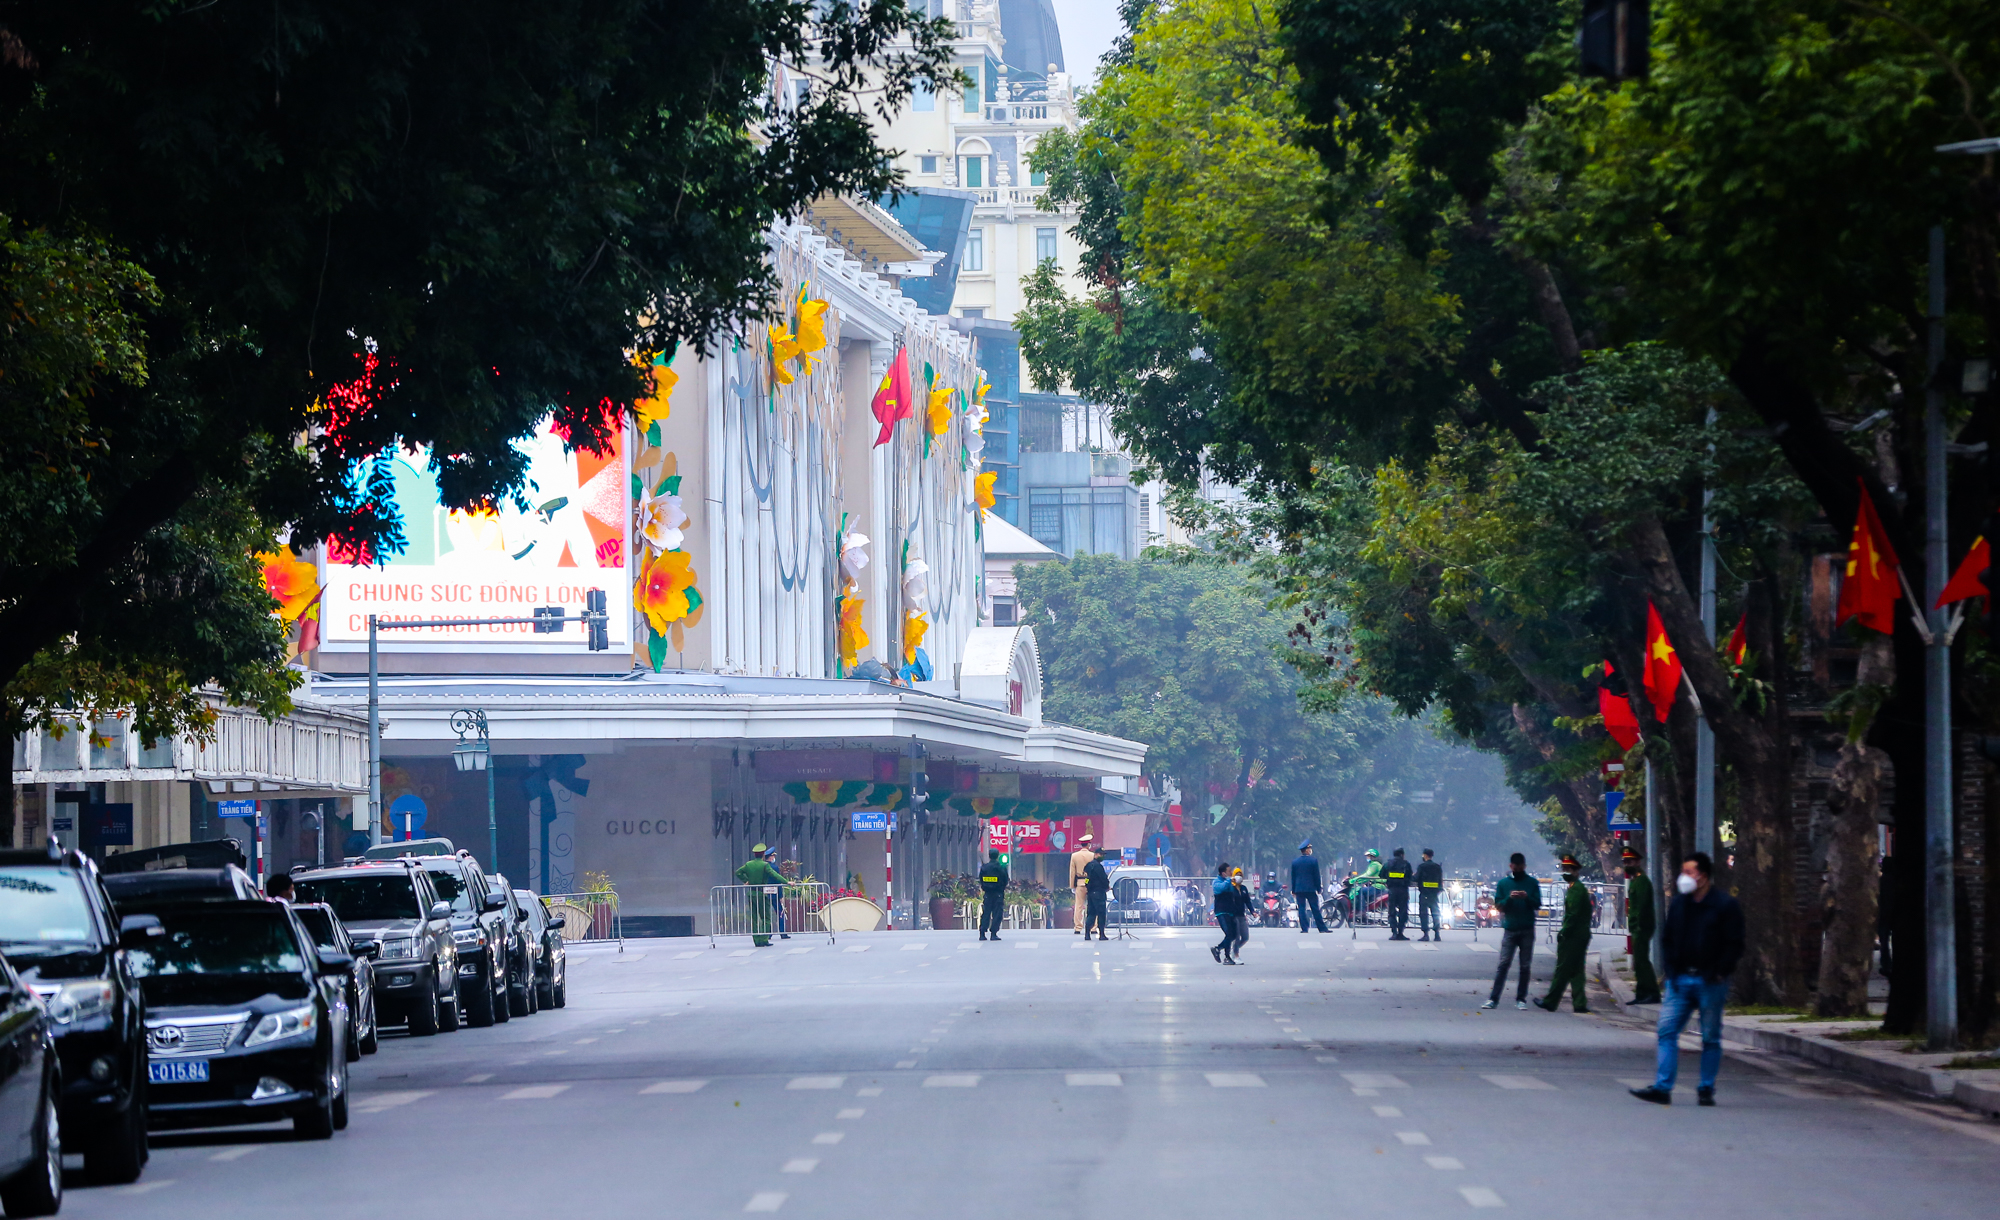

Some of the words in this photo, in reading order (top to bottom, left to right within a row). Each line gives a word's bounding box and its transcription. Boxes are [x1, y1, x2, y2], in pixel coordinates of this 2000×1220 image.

[348, 583, 423, 602] CHUNG
[431, 580, 472, 602] SỨC
[479, 580, 538, 603] ĐỒNG
[545, 582, 600, 604] LÒN
[606, 819, 676, 835] GUCCI
